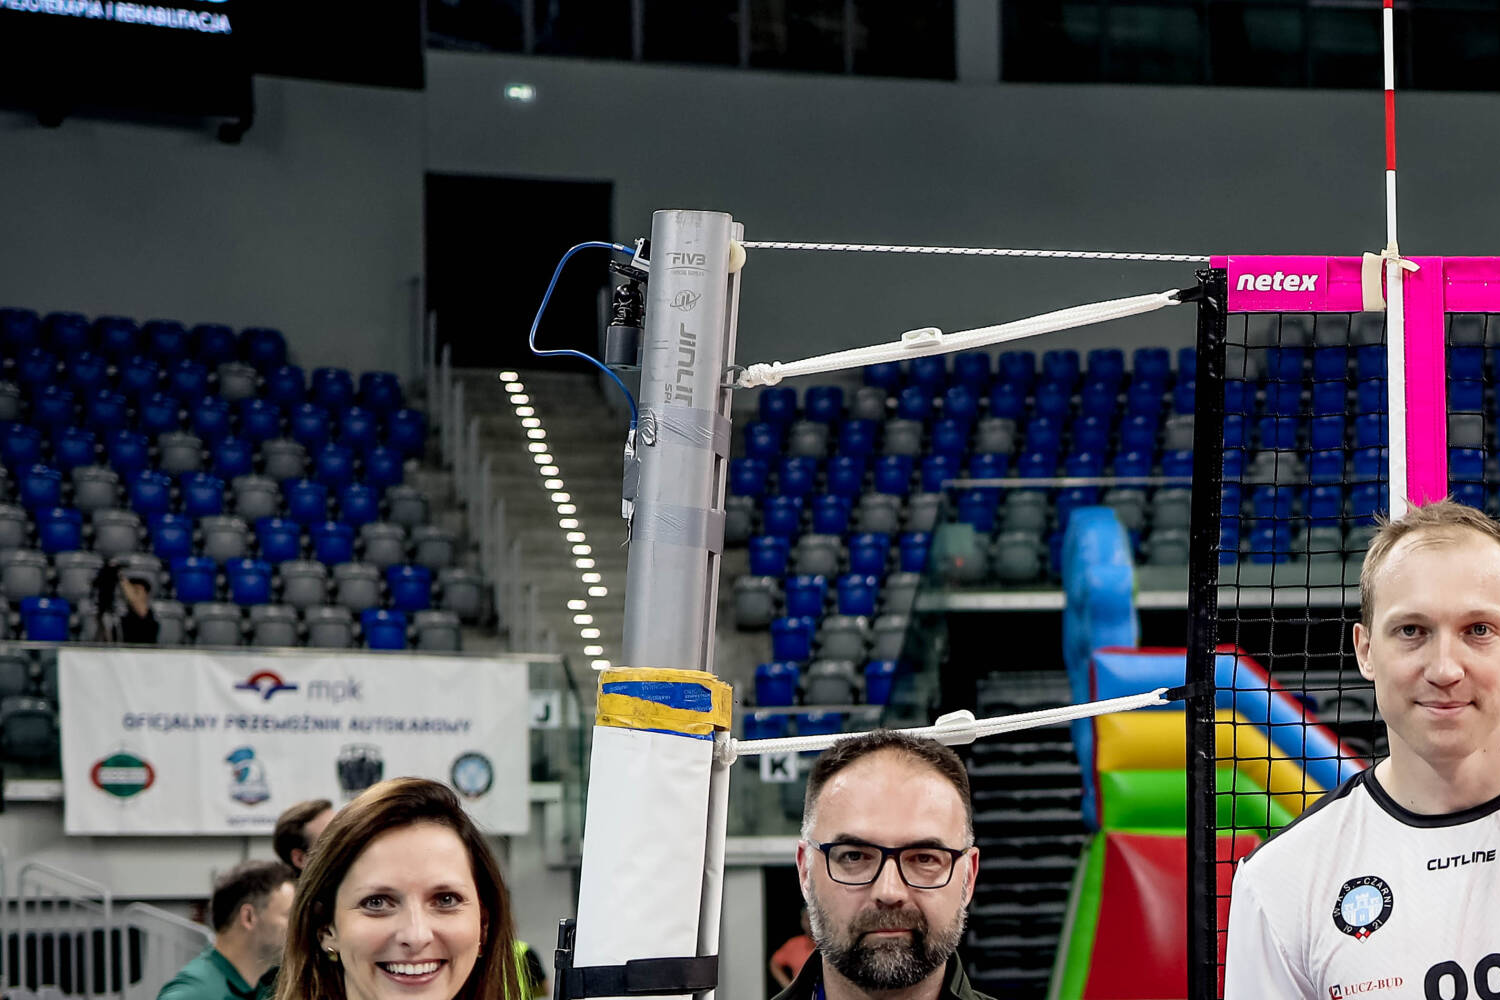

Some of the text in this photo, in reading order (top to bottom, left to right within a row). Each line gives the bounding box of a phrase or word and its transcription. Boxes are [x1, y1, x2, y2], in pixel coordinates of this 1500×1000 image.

[1237, 271, 1318, 291] netex
[307, 676, 363, 702] mpk
[122, 713, 217, 732] OFICJALNY
[348, 715, 471, 734] AUTOKAROWY
[535, 704, 551, 722] J
[771, 757, 788, 775] K
[1427, 849, 1497, 871] CUTLINE
[1363, 877, 1392, 908] CZARNI
